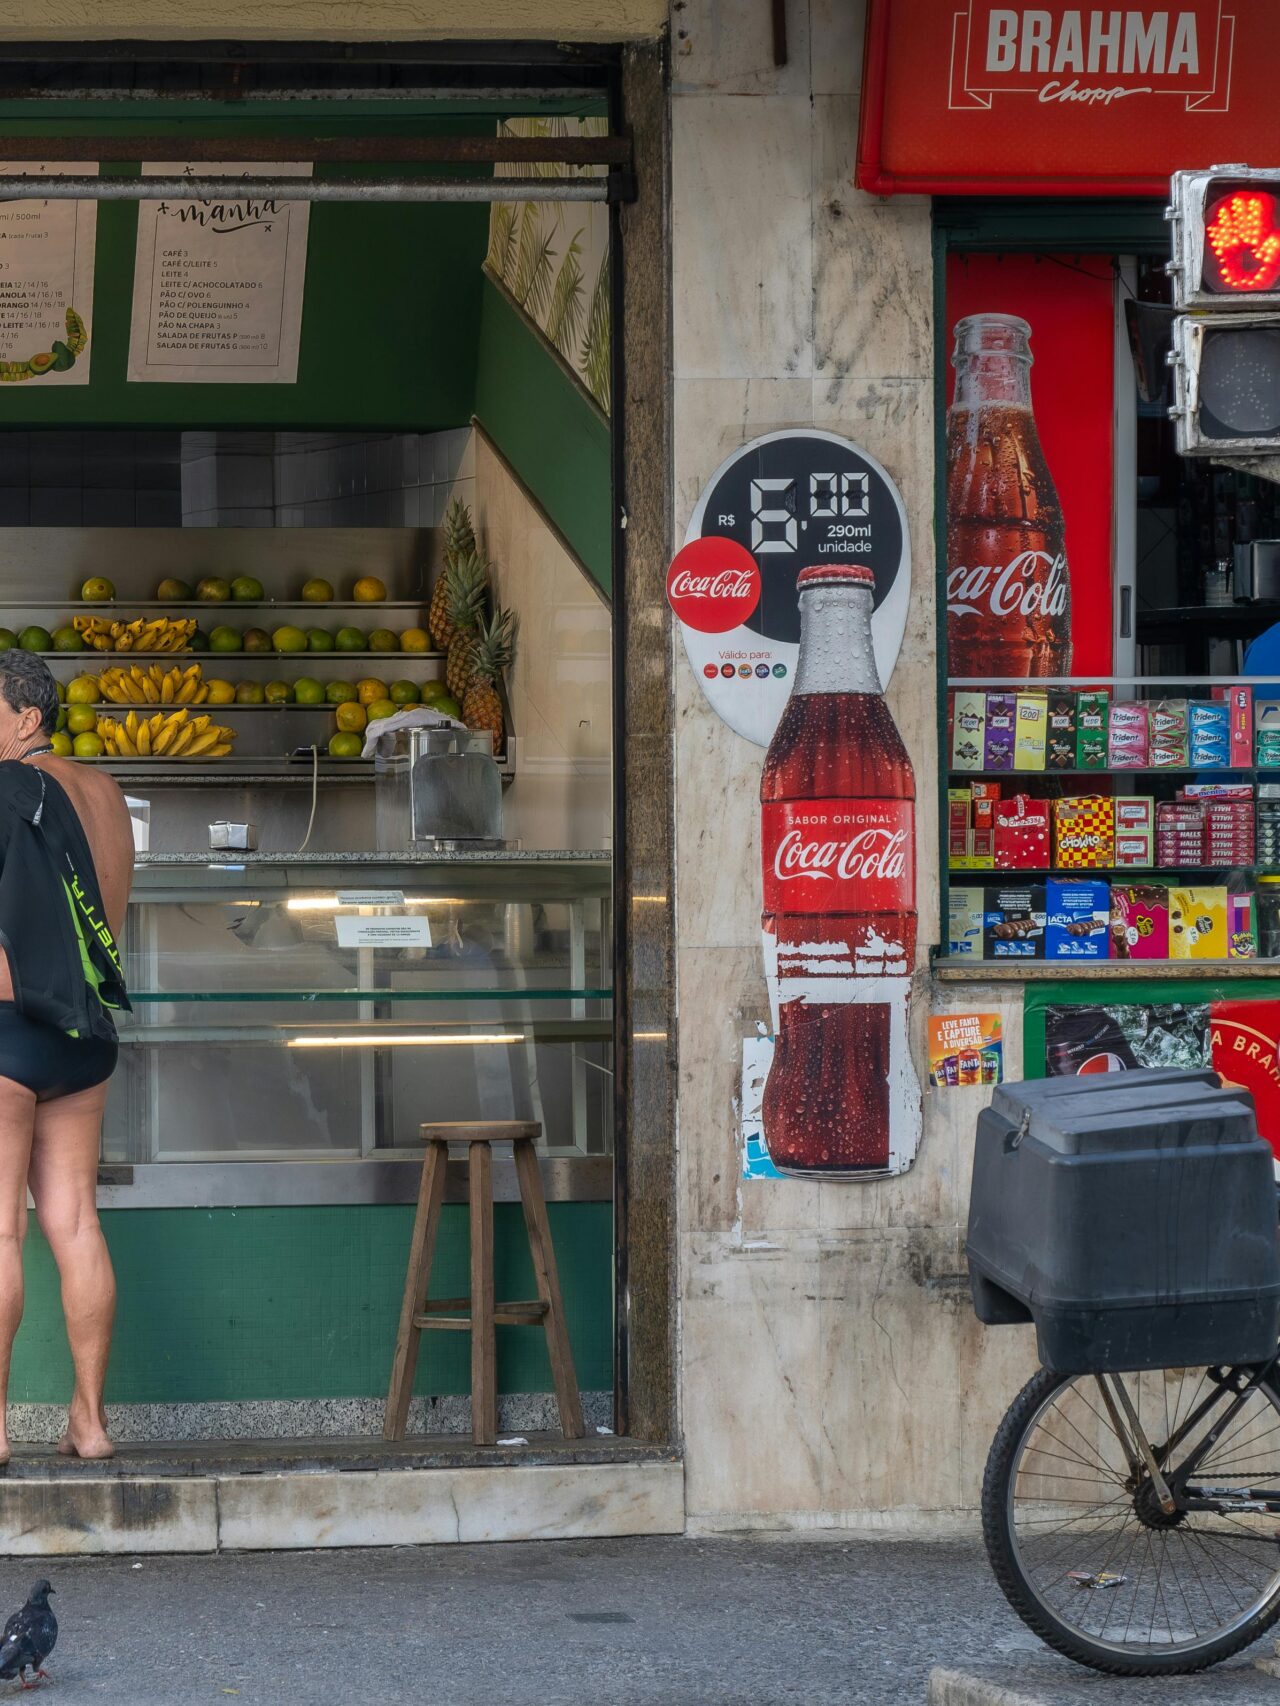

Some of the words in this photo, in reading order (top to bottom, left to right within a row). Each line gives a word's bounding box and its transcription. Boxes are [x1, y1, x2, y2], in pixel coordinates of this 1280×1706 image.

[986, 9, 1199, 74] BRAHMA
[1038, 80, 1152, 105] Chopp
[16, 213, 41, 221] 500ml
[163, 249, 183, 257] CAFÉ
[160, 290, 176, 298] PÃO
[159, 300, 175, 308] PÃO
[158, 321, 174, 329] PÃO
[718, 514, 736, 527] R$
[827, 524, 872, 538] 290ml
[818, 540, 872, 553] unidade
[671, 569, 751, 599] Coca-Cola
[718, 650, 747, 659] Válido
[1112, 713, 1139, 721] Trident
[1193, 713, 1221, 721] Trident
[1153, 718, 1179, 726] Trident
[1111, 733, 1139, 741] Trident
[1194, 733, 1221, 742] Trident
[1111, 754, 1138, 762] Trident
[1152, 752, 1179, 760] Trident
[1194, 753, 1221, 761] Trident
[788, 815, 827, 825] SABOR
[774, 829, 909, 880] Coca-Cola
[1048, 916, 1073, 927] LACTA
[942, 1020, 959, 1030] LEVE
[960, 1017, 979, 1027] FANTA
[937, 1031, 943, 1041] E
[945, 1026, 981, 1040] CAPTURE
[943, 1041, 948, 1049] A
